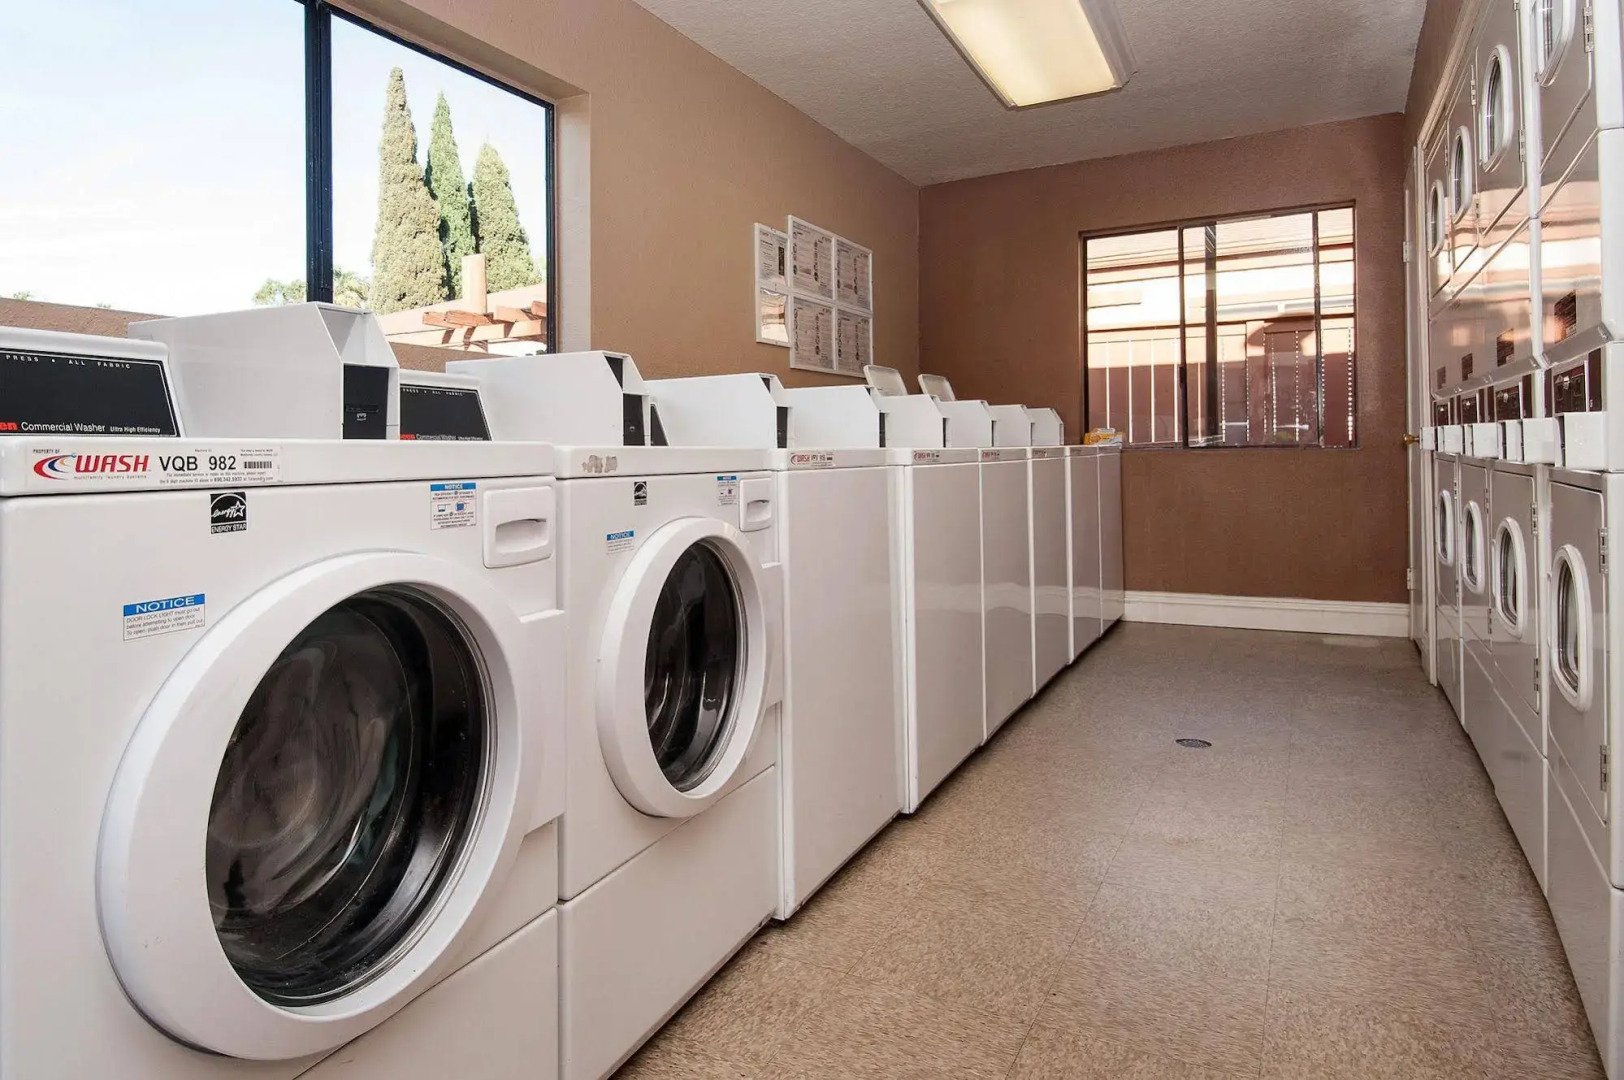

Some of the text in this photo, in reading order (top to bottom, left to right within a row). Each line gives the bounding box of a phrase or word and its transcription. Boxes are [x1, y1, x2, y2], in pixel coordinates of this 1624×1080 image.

[5, 354, 39, 362] PRESS
[21, 421, 73, 431] Commercial
[73, 422, 105, 432] Washer
[75, 455, 149, 473] WASH
[159, 455, 198, 472] VQB
[208, 455, 237, 471] 982
[211, 523, 247, 533] ENERGY STAR
[136, 596, 195, 613] NOTICE
[126, 615, 143, 623] DOOR
[142, 619, 167, 627] attempting
